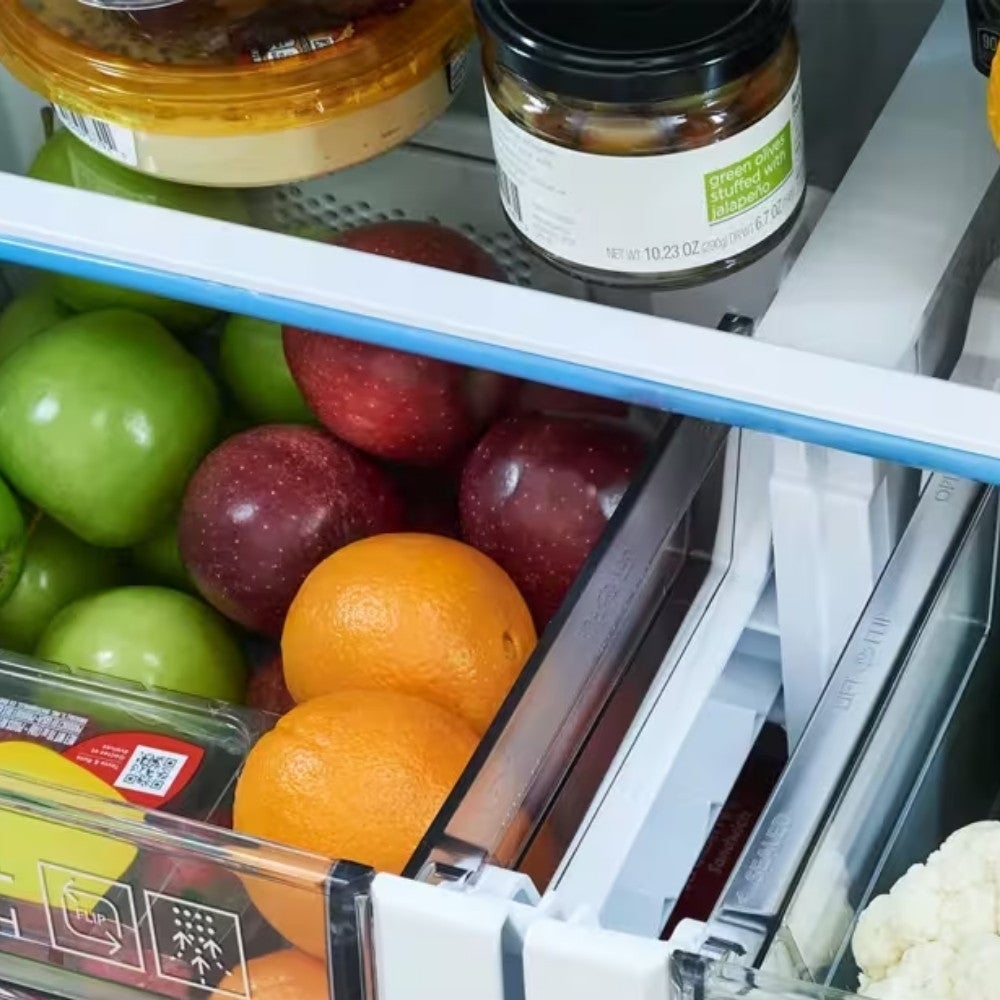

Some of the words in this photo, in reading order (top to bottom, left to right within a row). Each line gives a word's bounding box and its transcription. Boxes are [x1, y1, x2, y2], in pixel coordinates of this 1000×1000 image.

[708, 161, 752, 189] green
[755, 136, 785, 166] olives
[709, 171, 761, 202] stuffed
[763, 151, 787, 178] with
[644, 245, 680, 261] 10.23
[682, 240, 700, 256] OZ
